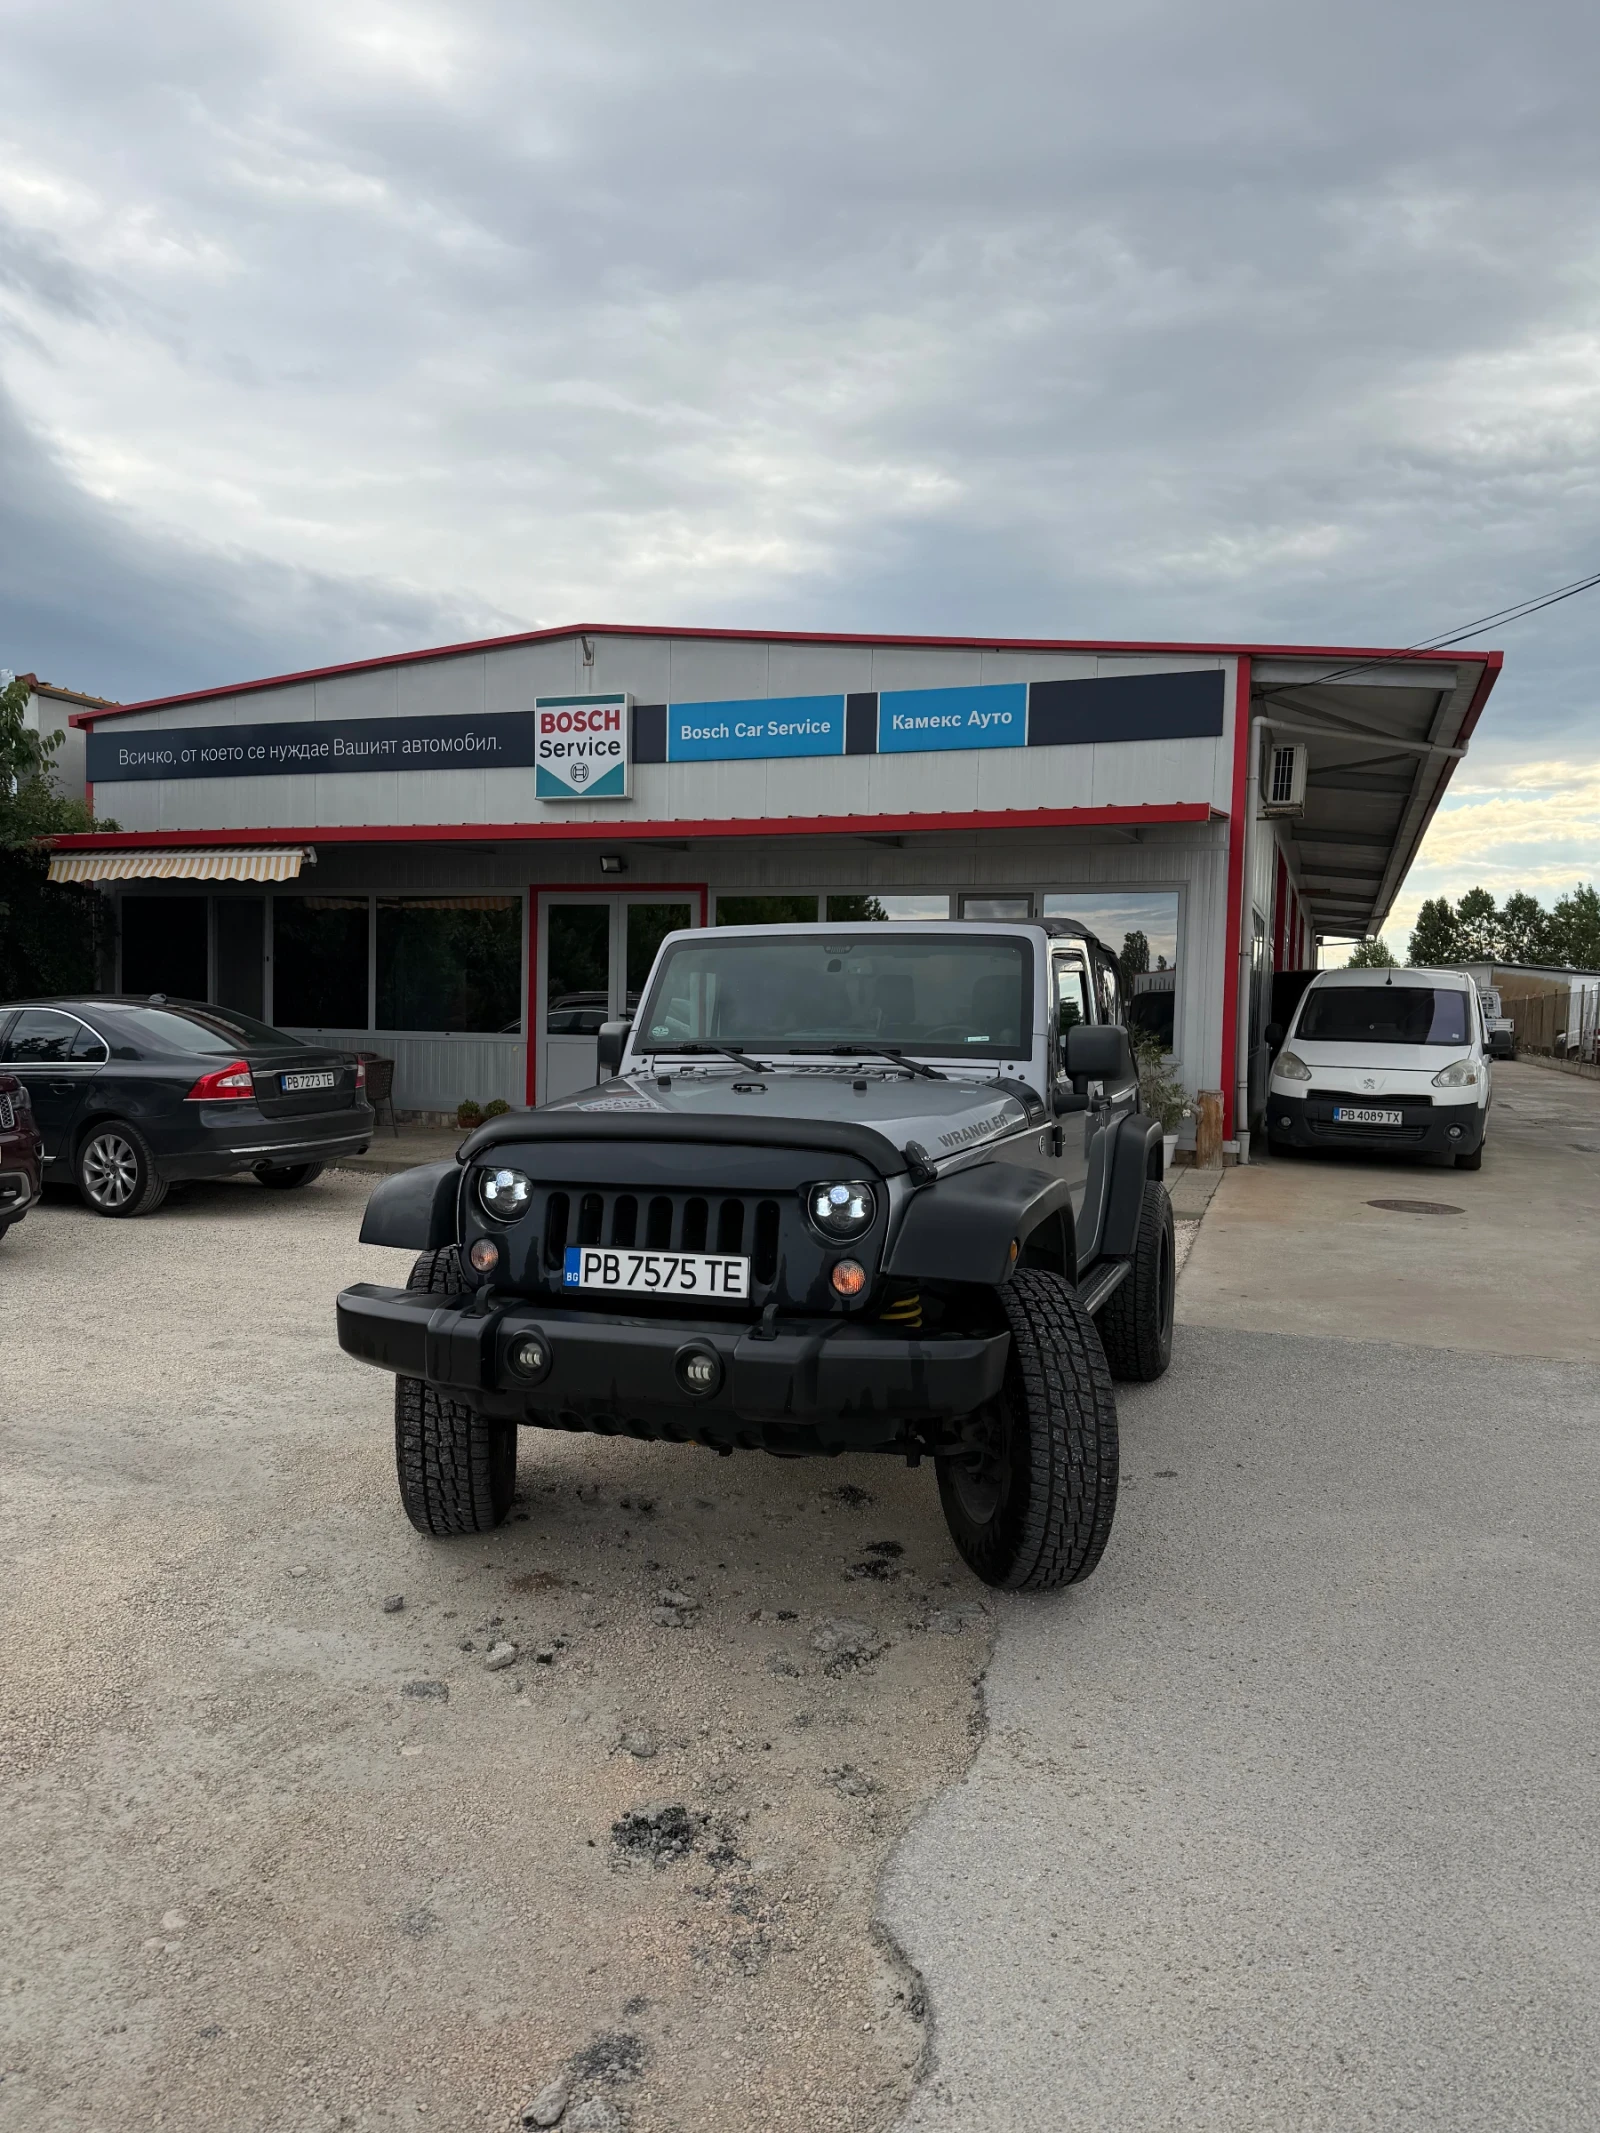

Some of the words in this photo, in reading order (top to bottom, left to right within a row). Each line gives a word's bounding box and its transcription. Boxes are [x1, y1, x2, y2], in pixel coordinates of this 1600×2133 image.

[540, 709, 621, 734] BOSCH
[681, 723, 729, 740] Bosch
[734, 722, 764, 737] Car
[767, 719, 831, 736] Service
[892, 714, 962, 730] Камекс
[967, 710, 1013, 729] Ауто
[119, 749, 177, 765] Всичко,
[180, 749, 197, 762] от
[200, 747, 243, 762] което
[247, 746, 265, 759] се
[270, 743, 329, 761] нуждае
[333, 738, 398, 756] Вашият
[402, 733, 502, 753] автомобил.
[539, 736, 621, 758] Service
[300, 1075, 320, 1087] 7273
[1357, 1110, 1383, 1122] 4089
[938, 1114, 1009, 1148] WRANGLER
[566, 1272, 579, 1282] BG
[584, 1252, 620, 1285] PB
[627, 1255, 697, 1290] 7575
[704, 1259, 742, 1293] TE
